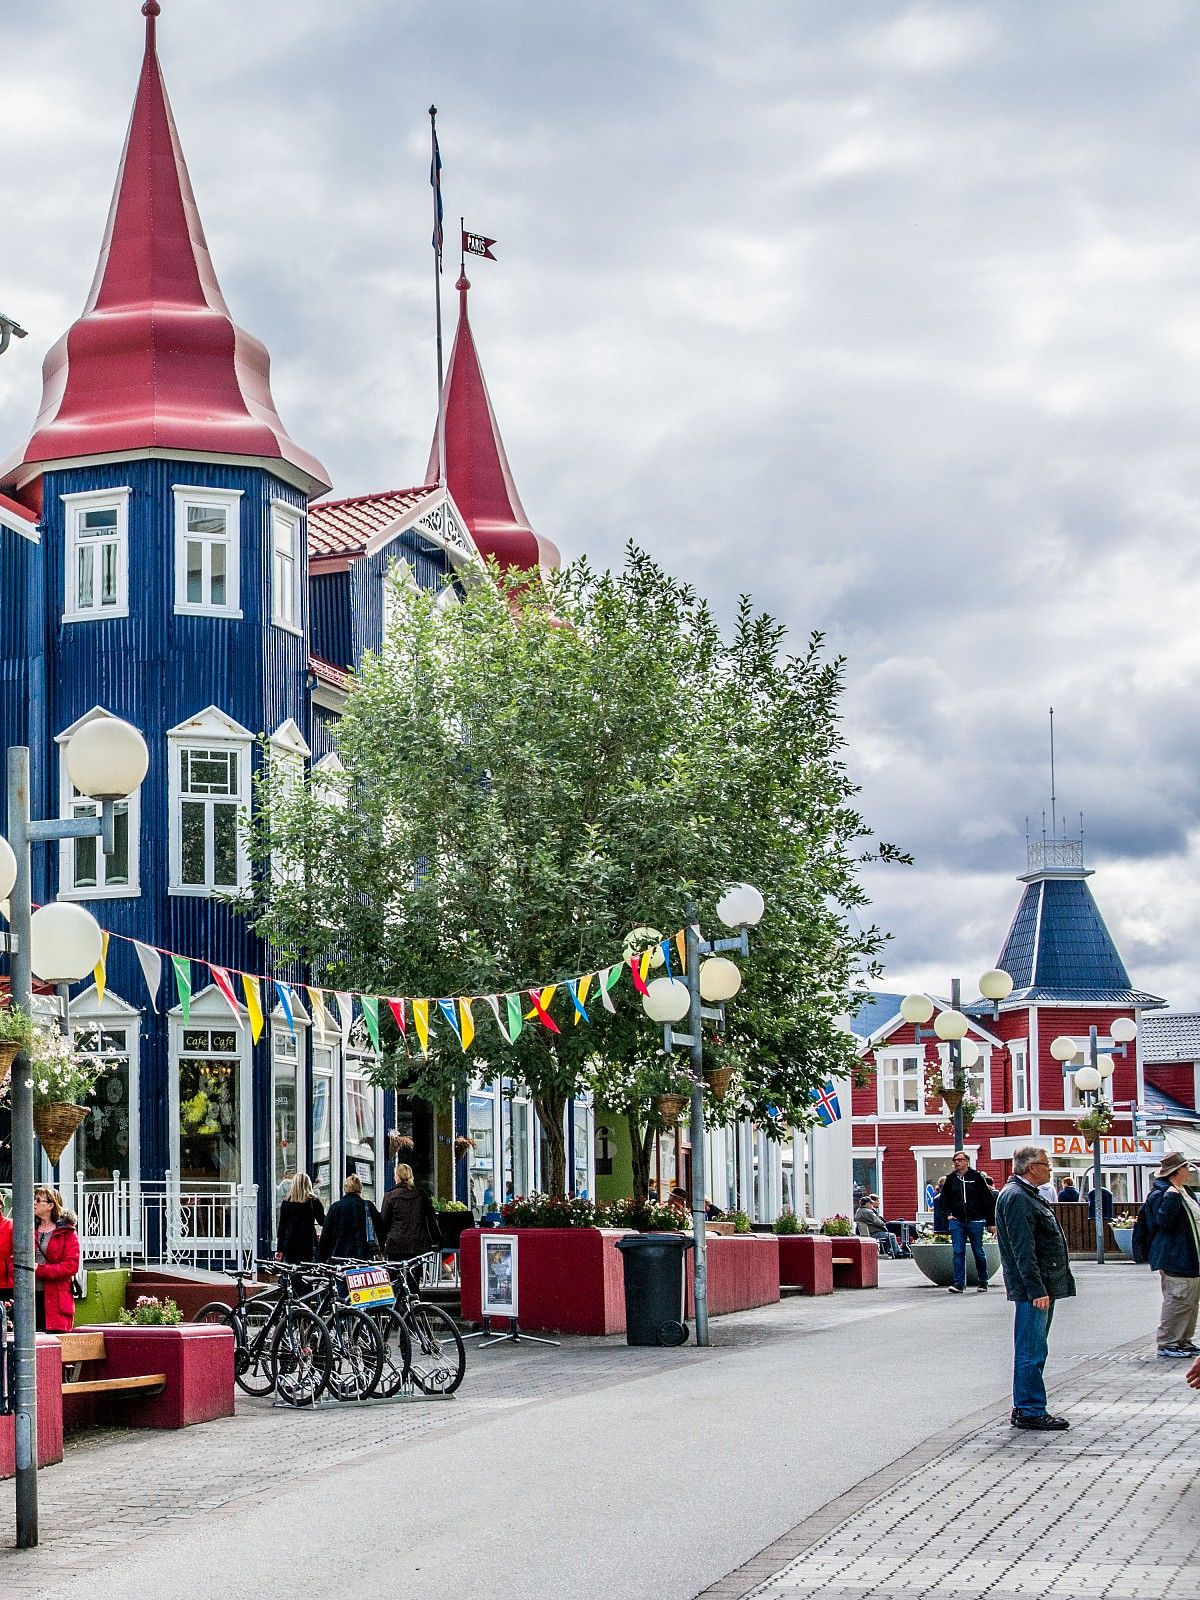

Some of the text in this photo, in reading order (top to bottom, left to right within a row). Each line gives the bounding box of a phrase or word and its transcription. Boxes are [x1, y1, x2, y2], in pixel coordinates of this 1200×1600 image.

[348, 1269, 389, 1288] RENT A BIKE
